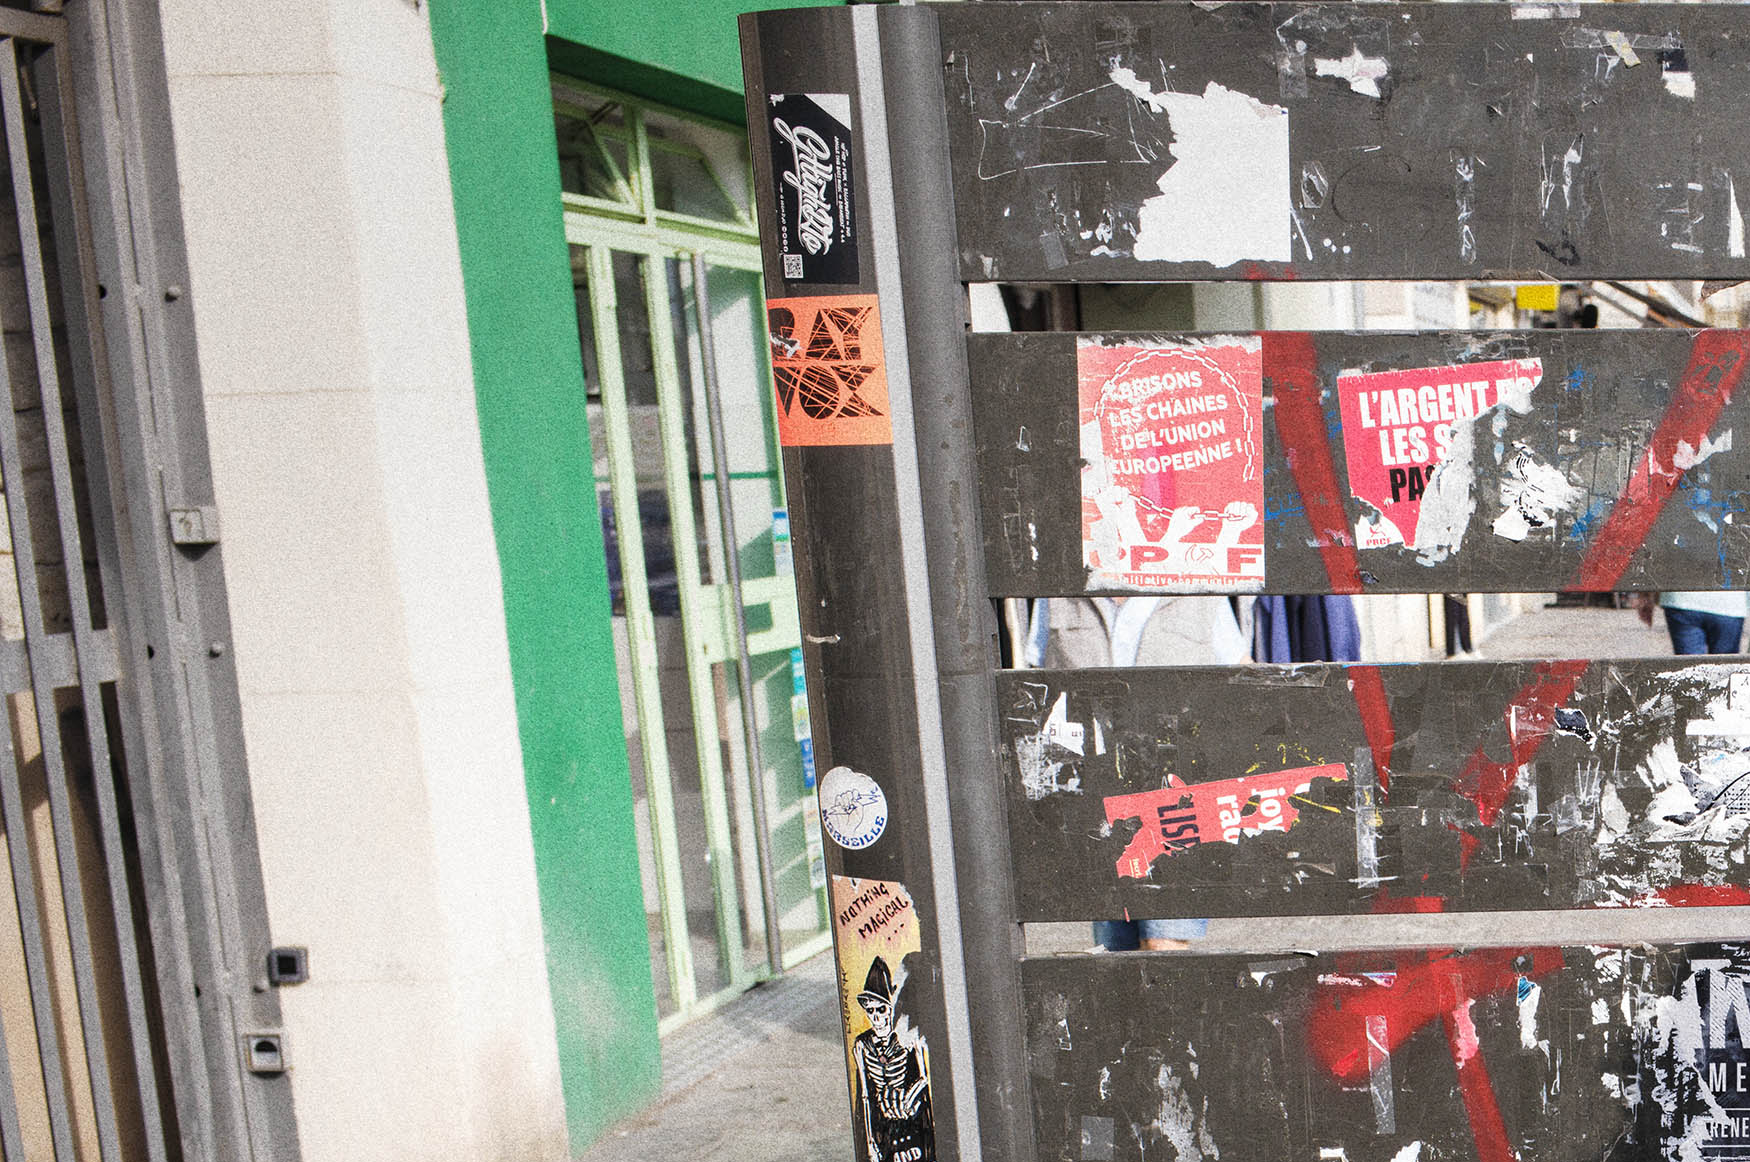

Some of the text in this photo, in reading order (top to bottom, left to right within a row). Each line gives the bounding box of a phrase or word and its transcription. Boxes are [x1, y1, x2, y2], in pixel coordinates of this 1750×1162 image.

[1108, 394, 1228, 428] LES CHAINES
[1358, 380, 1490, 429] L'ARGENT
[1379, 425, 1430, 466] LES
